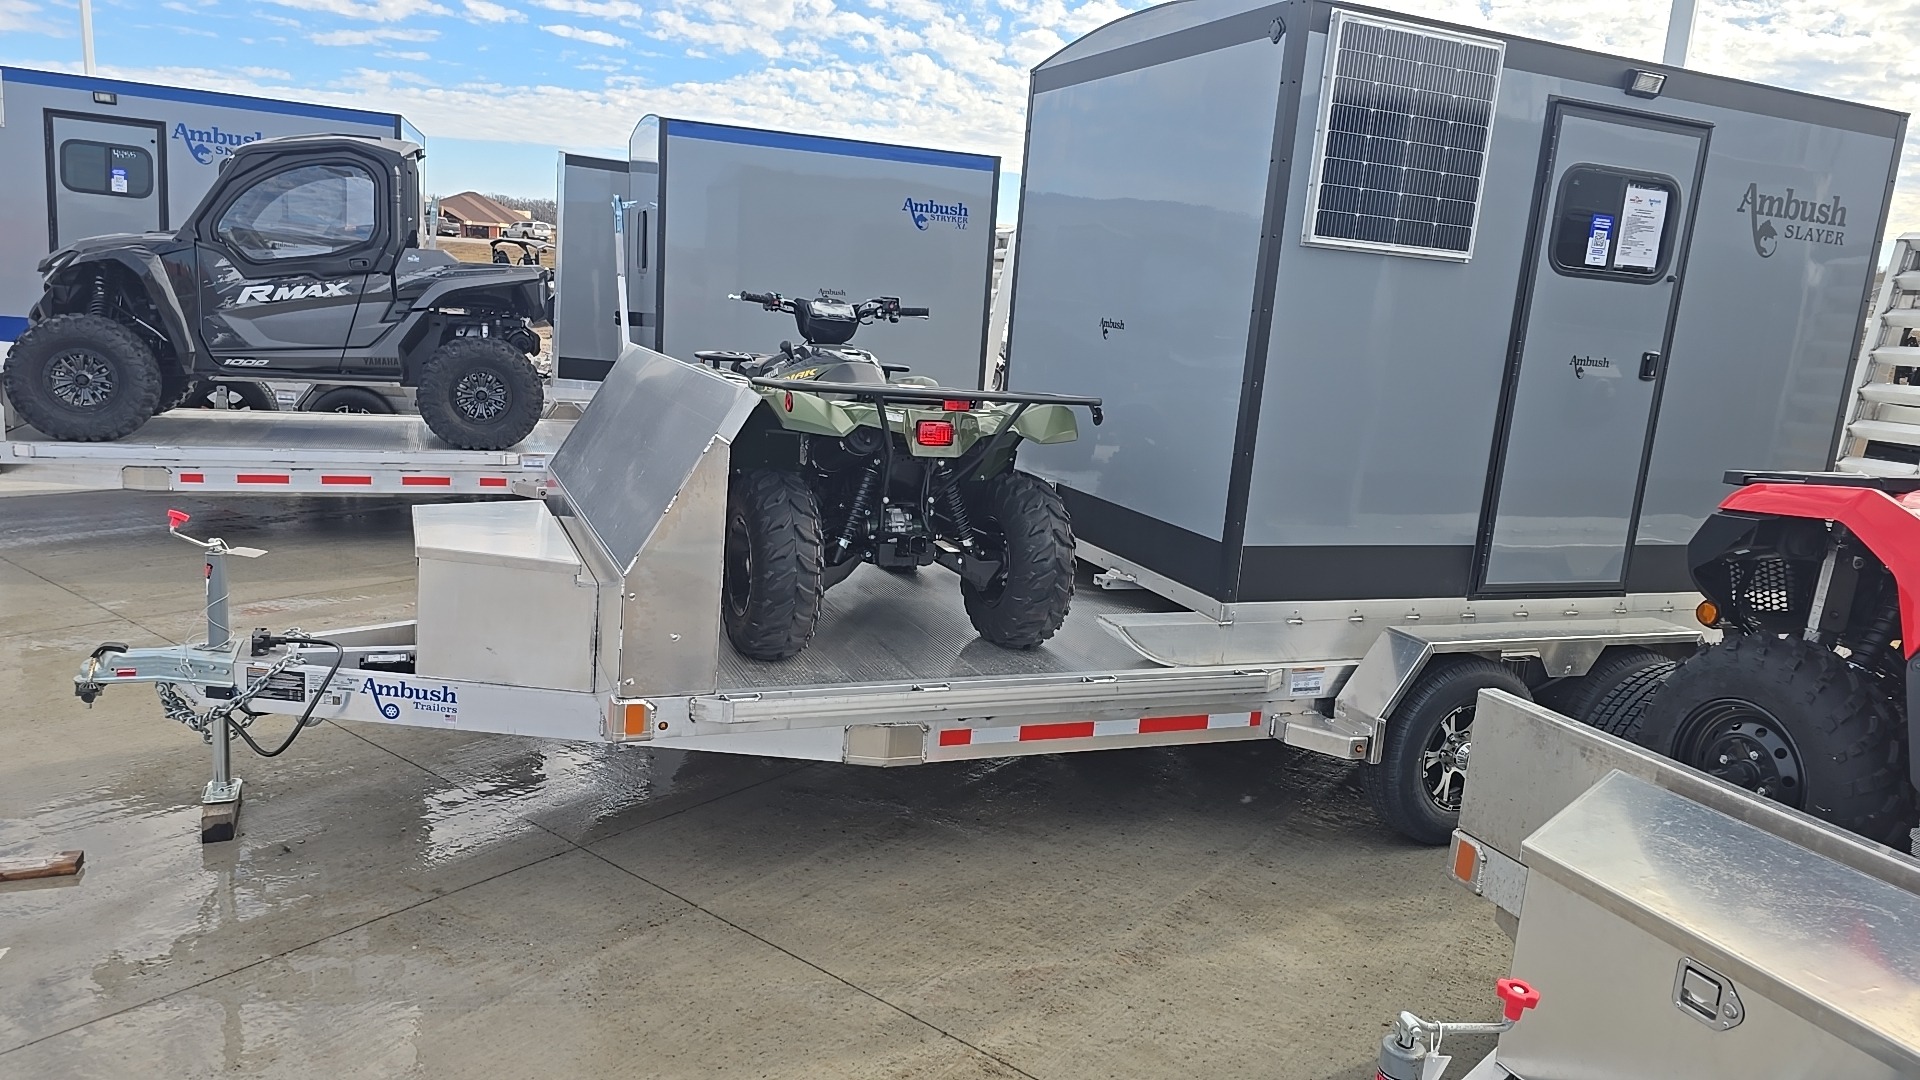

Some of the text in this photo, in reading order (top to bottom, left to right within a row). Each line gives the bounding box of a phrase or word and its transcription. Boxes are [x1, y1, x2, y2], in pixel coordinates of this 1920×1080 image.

[901, 197, 969, 217] Ambush
[1736, 182, 1848, 228] Ambush
[929, 213, 969, 224] STRYKER
[1784, 224, 1846, 246] SLAYER
[224, 358, 270, 366] 1000
[362, 356, 400, 366] YAMAHA
[1569, 355, 1610, 369] Ambush
[360, 677, 458, 704] Ambush
[413, 700, 458, 714] Trailers
